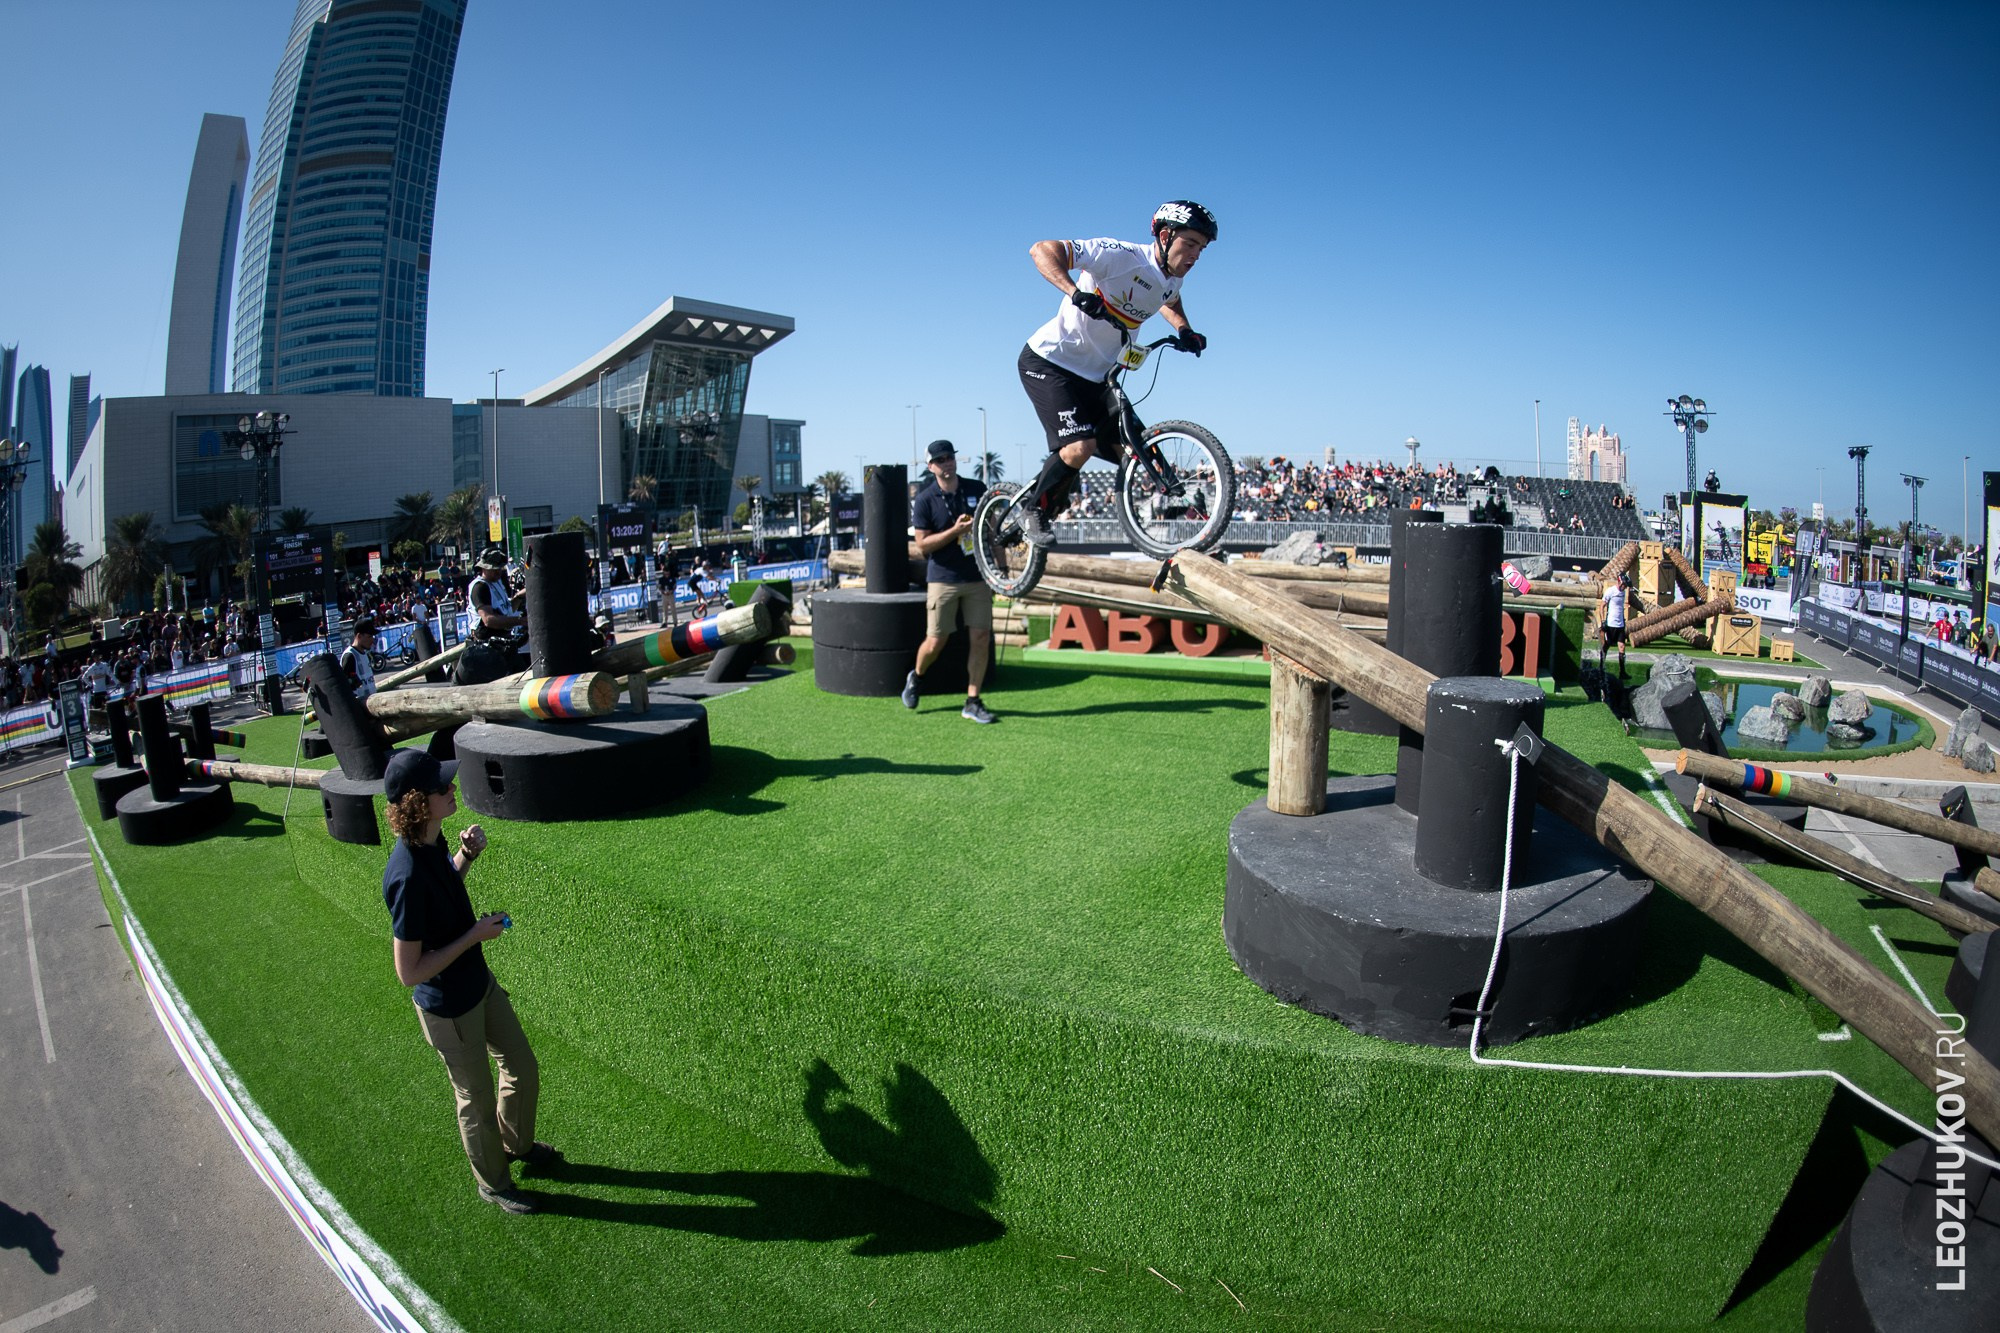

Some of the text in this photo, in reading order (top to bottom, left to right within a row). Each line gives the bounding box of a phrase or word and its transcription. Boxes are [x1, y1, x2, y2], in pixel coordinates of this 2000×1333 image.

[611, 524, 644, 537] 13:20:27
[283, 541, 303, 549] FINISH
[762, 566, 810, 580] SHIMANO
[675, 577, 731, 598] SHMANO
[1735, 595, 1771, 611] SOT
[445, 622, 454, 633] 4
[1048, 604, 1227, 657] ABU
[1924, 656, 1932, 666] bike
[1939, 662, 1949, 673] dhabi
[1952, 667, 1960, 678] bike
[1967, 675, 1979, 686] dhabi
[1982, 681, 1991, 692] bike
[1991, 685, 1999, 696] abu
[63, 693, 79, 701] START
[68, 701, 77, 716] 3
